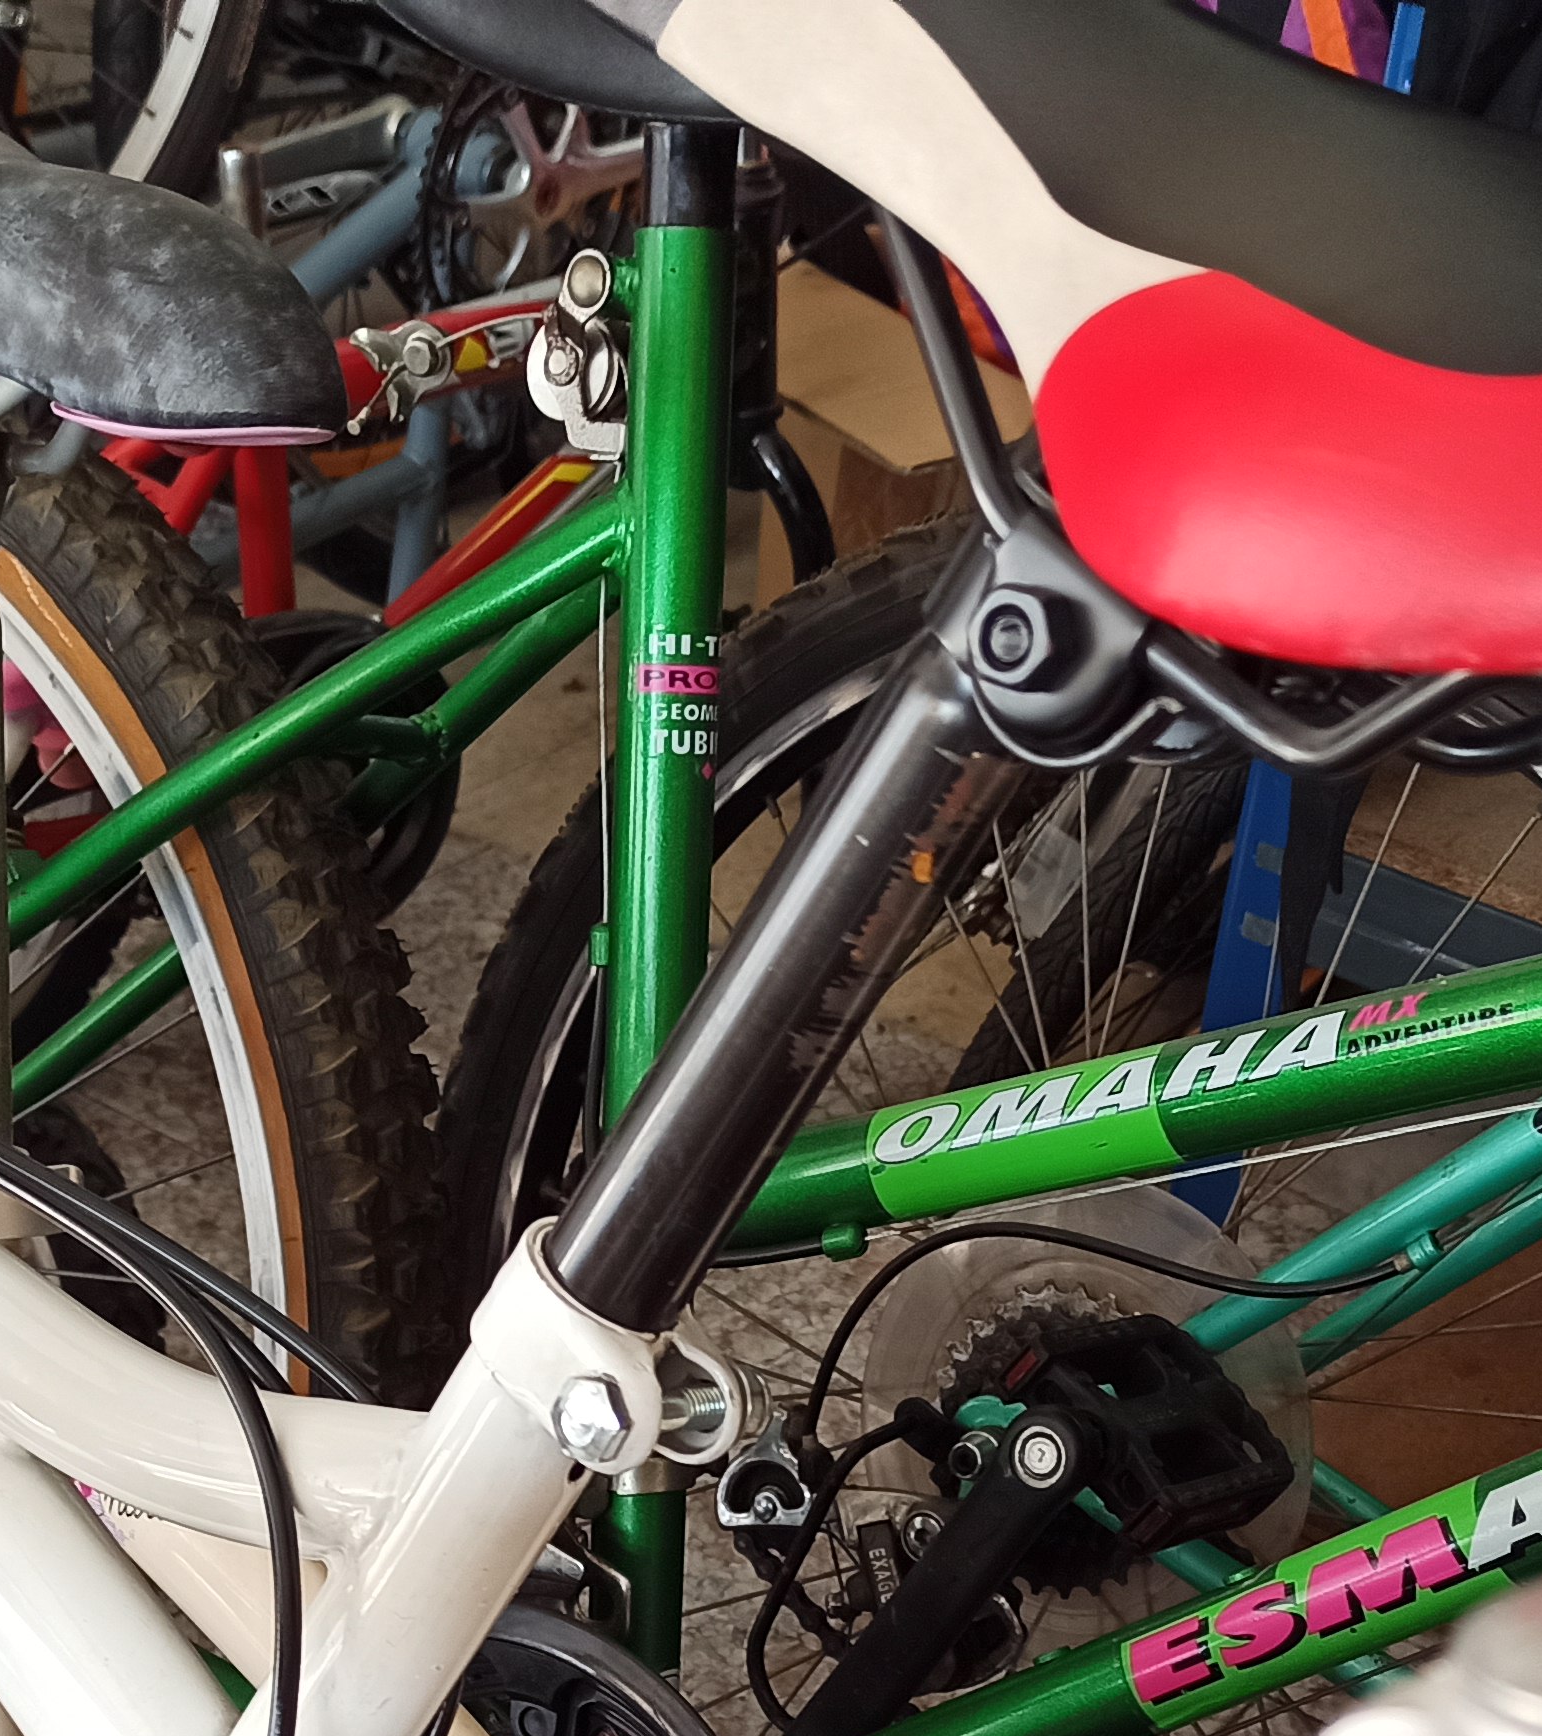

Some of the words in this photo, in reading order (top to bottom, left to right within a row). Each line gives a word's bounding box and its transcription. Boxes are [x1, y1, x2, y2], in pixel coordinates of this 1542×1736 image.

[648, 633, 722, 657] HI-T
[1344, 1002, 1515, 1059] ADVENTURE
[871, 1010, 1347, 1165] OMAHA
[1347, 991, 1430, 1033] MX
